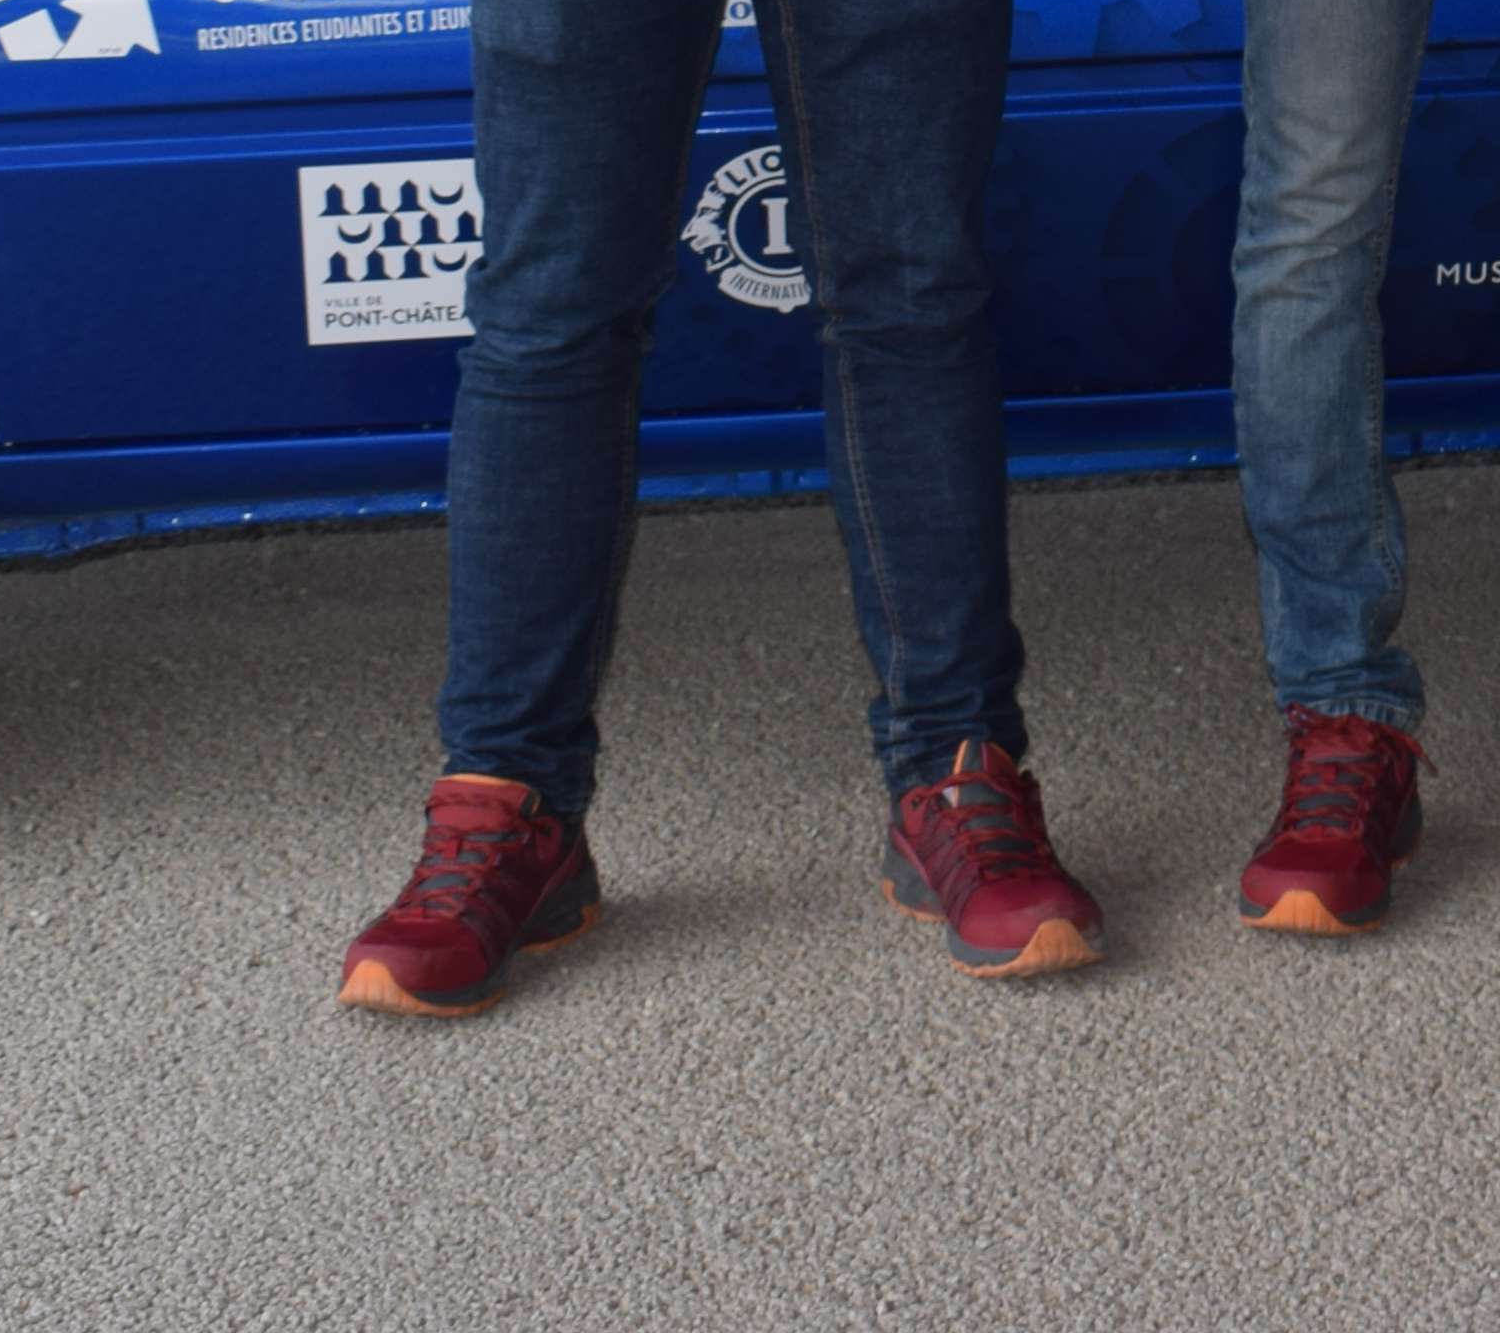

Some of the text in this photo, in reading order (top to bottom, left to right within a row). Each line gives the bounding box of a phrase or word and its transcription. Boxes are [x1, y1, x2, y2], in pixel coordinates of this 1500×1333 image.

[198, 21, 297, 50] RESIDENCES
[302, 12, 401, 42] ETUDIANTES
[406, 10, 424, 32] ET
[729, 272, 810, 300] INTERNATI
[325, 295, 382, 307] VILLE DE
